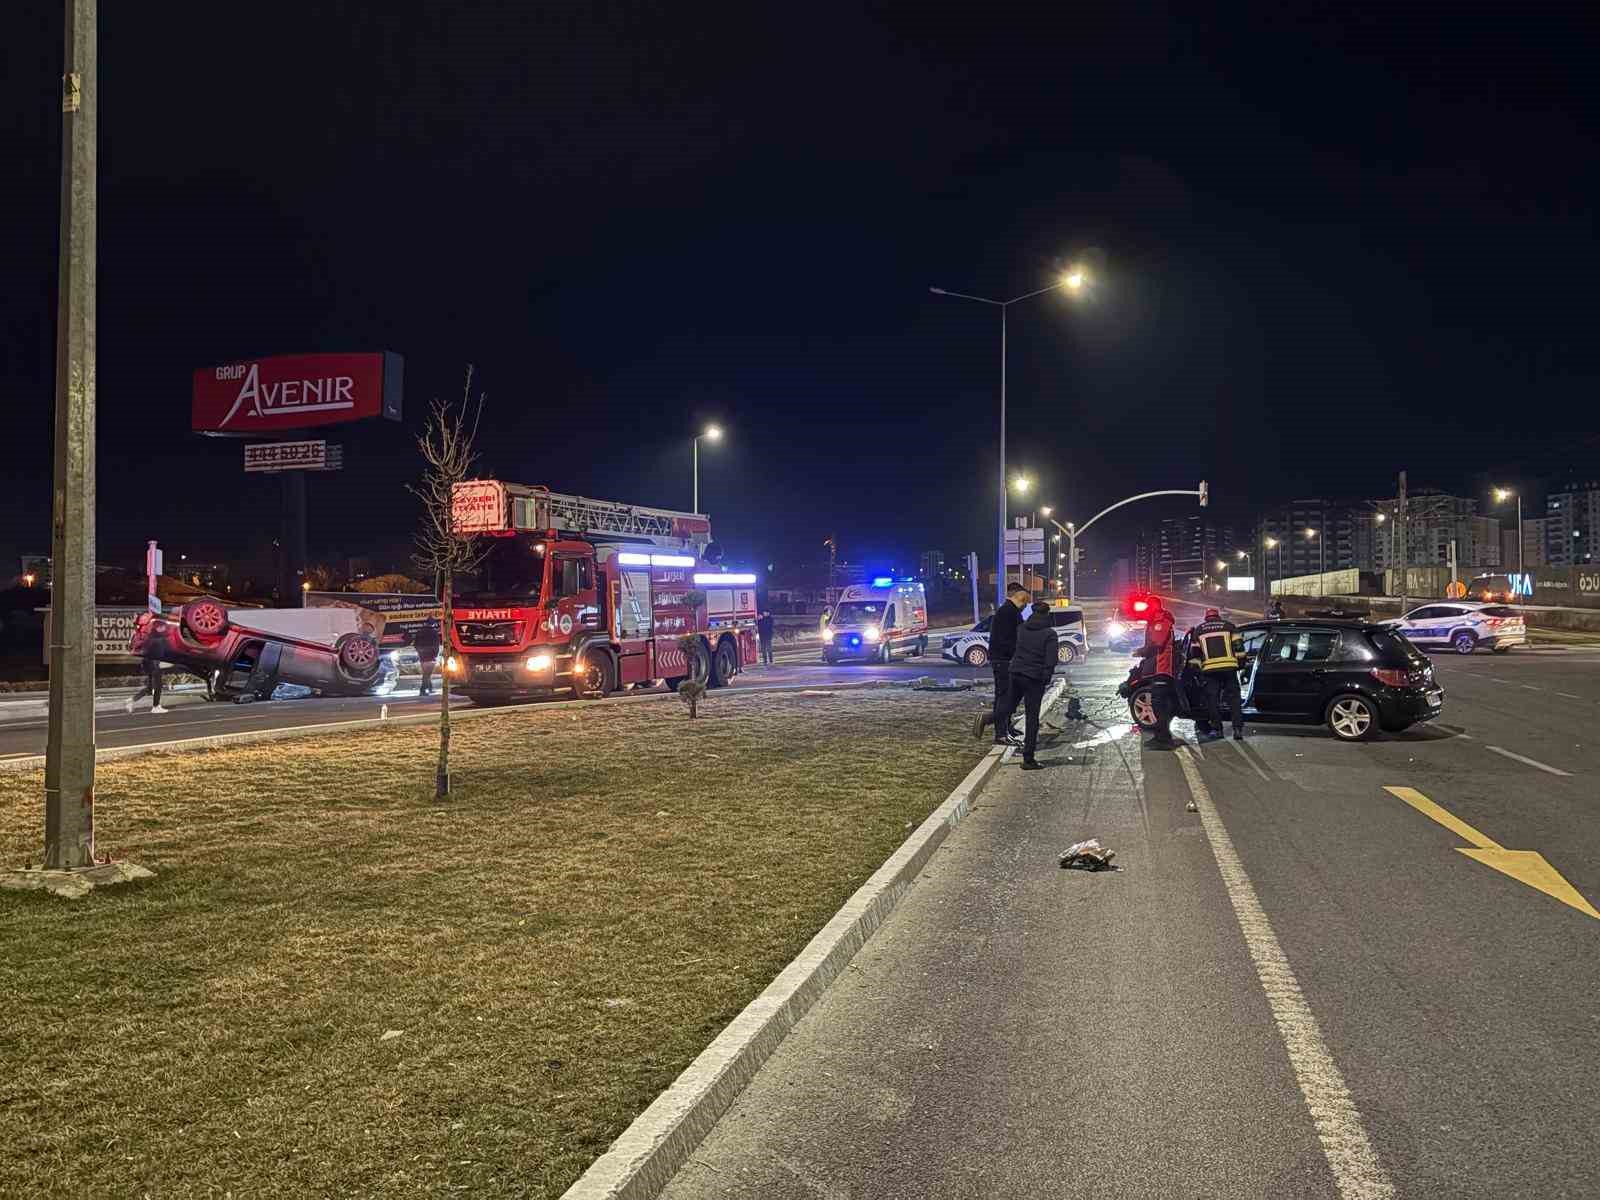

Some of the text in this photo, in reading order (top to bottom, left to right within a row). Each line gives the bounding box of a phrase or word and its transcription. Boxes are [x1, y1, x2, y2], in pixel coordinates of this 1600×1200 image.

[215, 364, 246, 380] GRUP
[218, 364, 354, 428] AVENIR
[94, 617, 135, 628] LEFON
